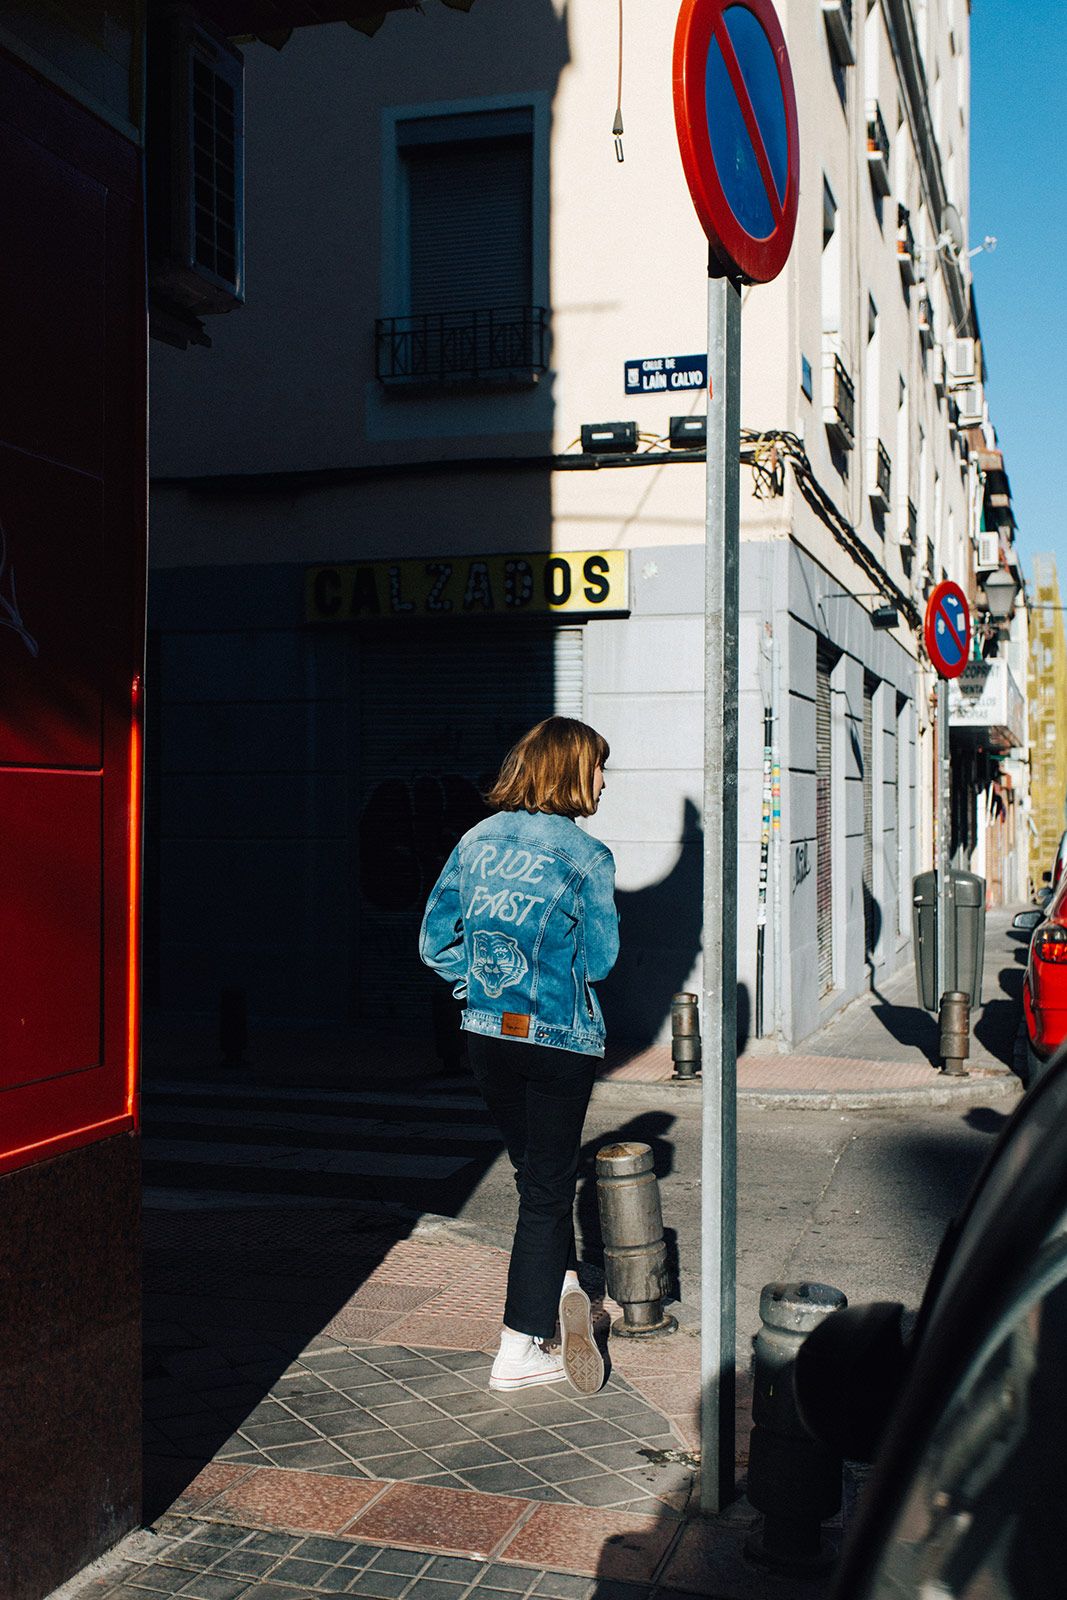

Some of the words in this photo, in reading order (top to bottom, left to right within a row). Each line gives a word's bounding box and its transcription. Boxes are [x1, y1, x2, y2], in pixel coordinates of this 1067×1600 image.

[642, 360, 663, 371] CALLE
[665, 358, 676, 369] DE
[671, 370, 703, 387] CALVO
[313, 554, 611, 615] CALZADOS
[470, 845, 556, 885] RIDE
[465, 885, 545, 927] FAST
